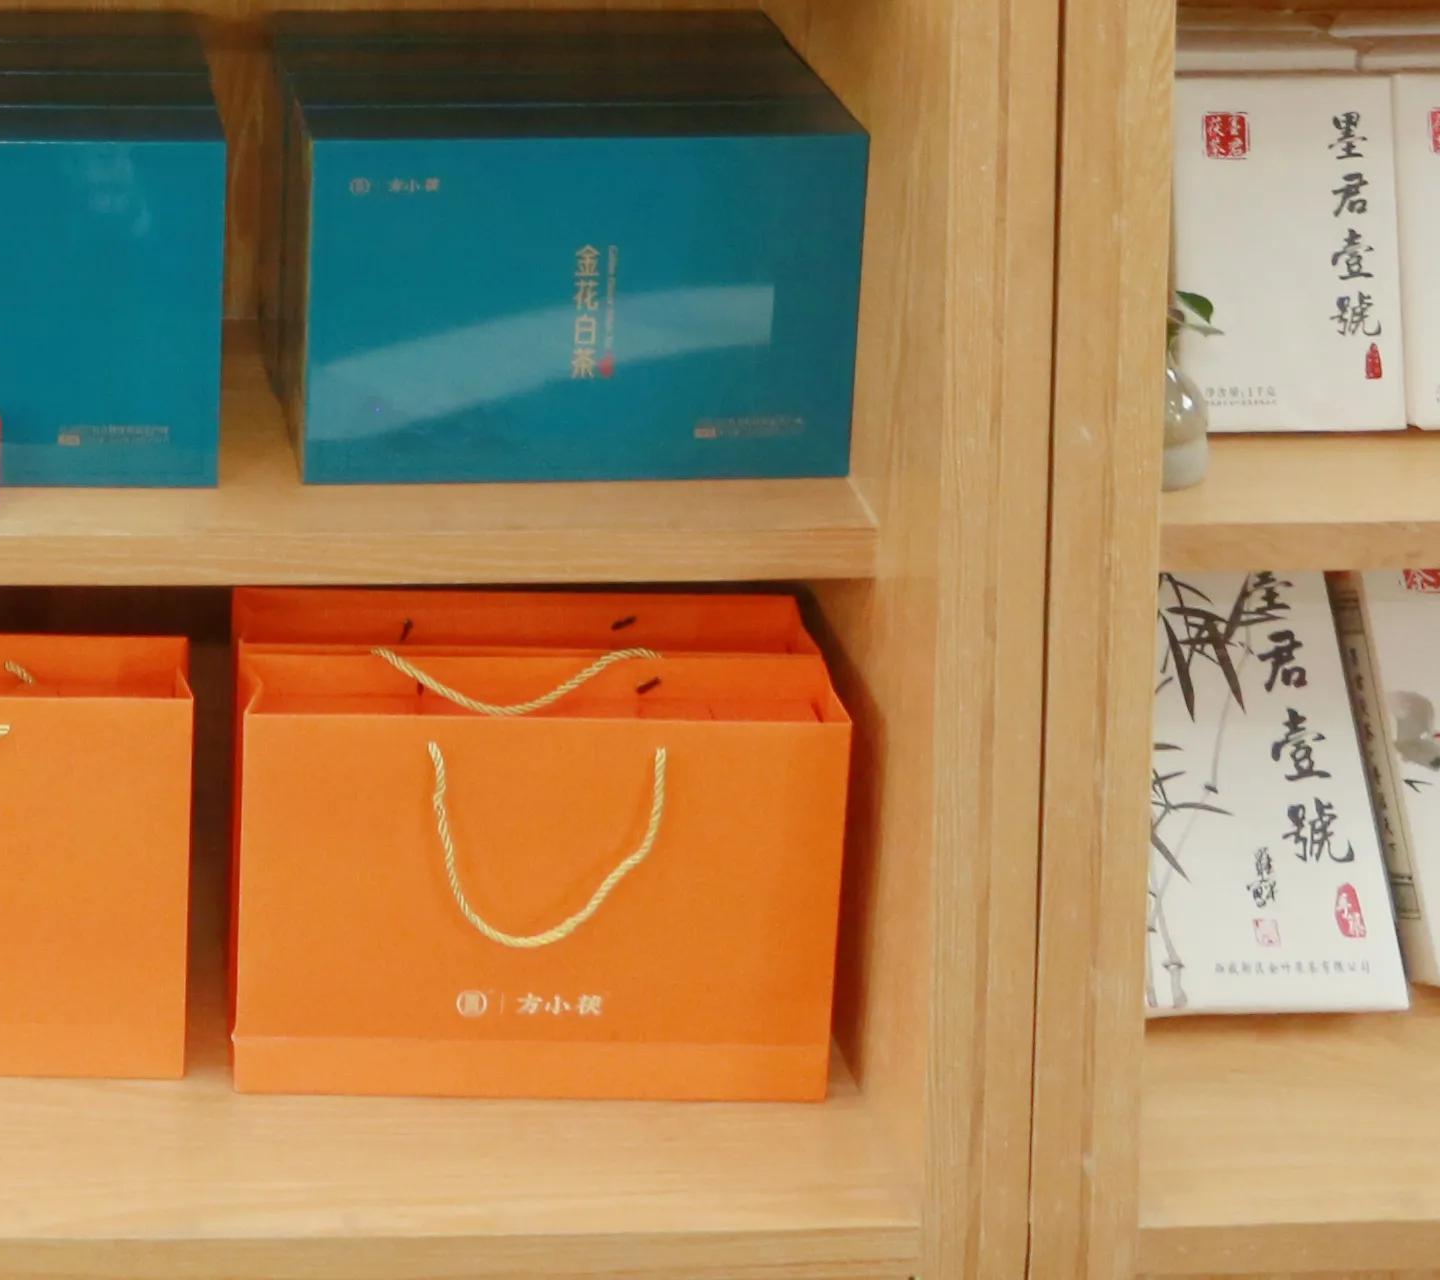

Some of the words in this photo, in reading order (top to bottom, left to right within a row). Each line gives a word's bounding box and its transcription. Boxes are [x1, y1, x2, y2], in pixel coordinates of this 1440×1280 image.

[571, 245, 599, 379] 金花白茶
[1327, 111, 1383, 337] 墨君壹號
